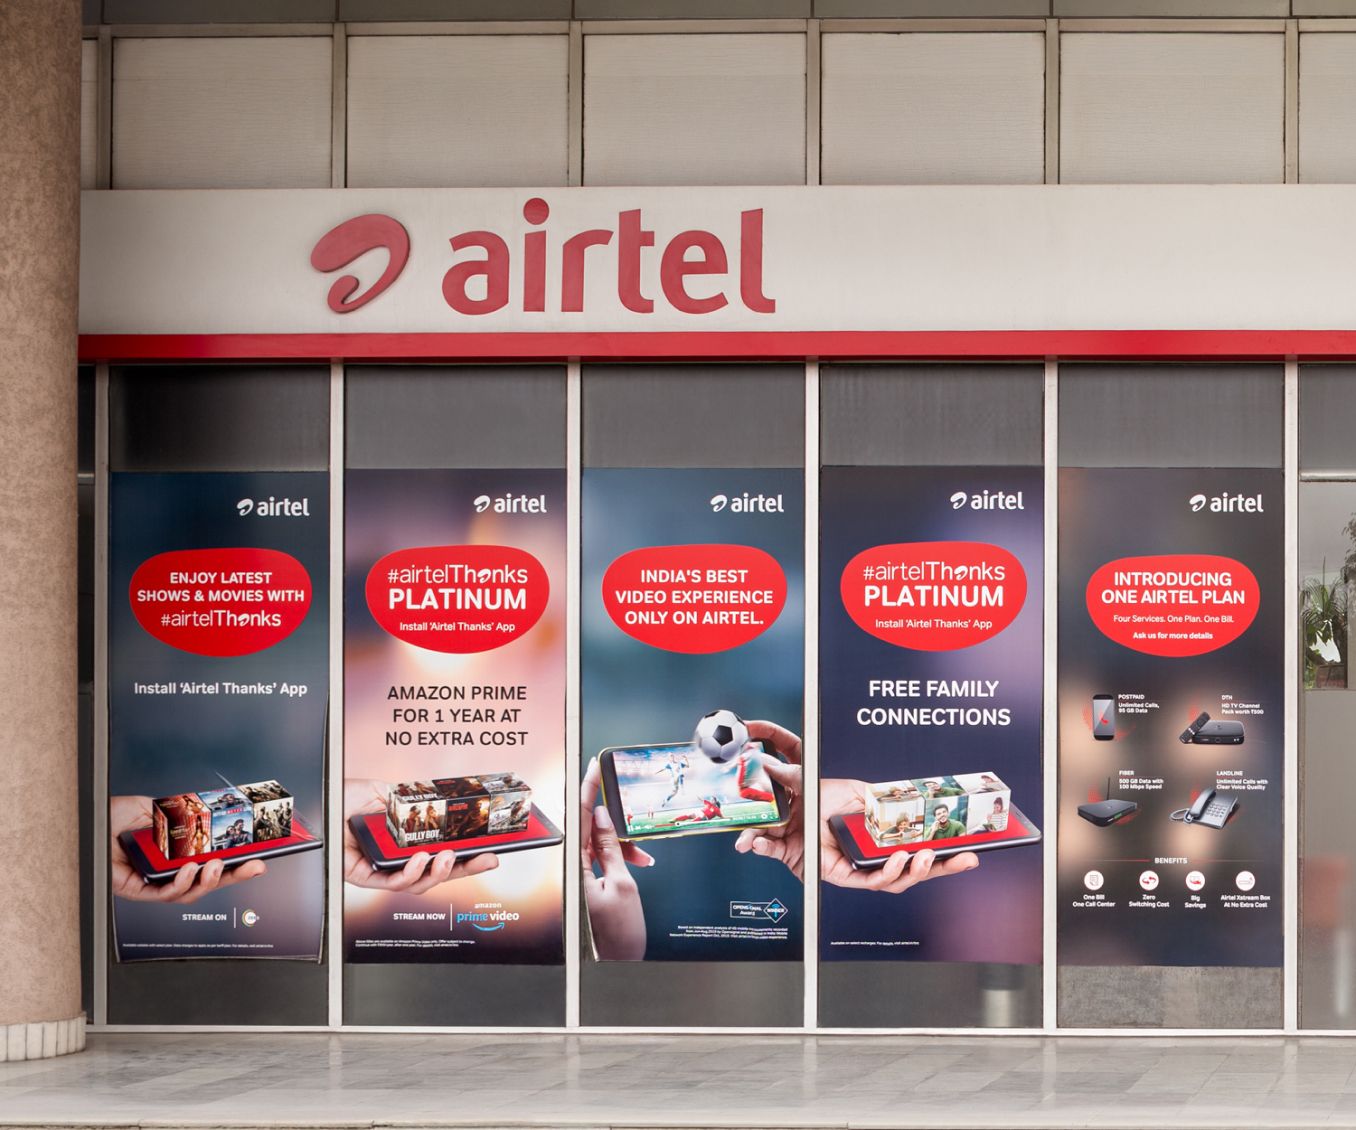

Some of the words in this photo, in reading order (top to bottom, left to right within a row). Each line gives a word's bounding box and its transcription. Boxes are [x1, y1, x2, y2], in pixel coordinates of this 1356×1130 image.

[442, 197, 776, 315] airtel
[257, 496, 310, 517] airtel
[494, 494, 547, 513] airtel
[731, 492, 784, 513] airtel
[971, 491, 1024, 510] airtel
[1210, 492, 1264, 512] airtel
[169, 572, 217, 584] ENJOY
[221, 572, 272, 584] LATEST
[641, 569, 701, 584] INDIA'S
[706, 569, 748, 584] BEST
[1114, 572, 1232, 586] INTRODUCING
[137, 589, 190, 602] SHOWS
[193, 589, 205, 602] &
[208, 589, 265, 602] MOVIES
[269, 589, 304, 602] WITH
[388, 588, 526, 610] PLATINUM
[615, 590, 666, 604] VIDEO
[671, 590, 773, 605] EXPERIENCE
[864, 586, 1004, 608] PLATINUM
[1102, 590, 1137, 604] ONE
[1141, 590, 1198, 604] AIRTEL
[1202, 590, 1245, 604] PLAN
[625, 611, 668, 625] ONLY
[673, 611, 698, 625] ON
[703, 611, 764, 625] AIRTEL.
[875, 619, 903, 629] Install
[973, 619, 992, 631] App
[399, 622, 427, 631] Install
[496, 622, 515, 633] App
[134, 682, 177, 695] Install
[281, 683, 307, 697] App
[387, 686, 465, 701] AMAZON
[471, 686, 527, 701] PRIME
[869, 680, 920, 697] FREE
[926, 680, 999, 698] FAMILY
[393, 708, 428, 723] FOR
[434, 708, 443, 723] 1
[449, 708, 495, 723] YEAR
[500, 708, 521, 723] AT
[856, 708, 1011, 726] CONNECTIONS
[385, 731, 412, 746] NO
[418, 731, 474, 746] EXTRA
[479, 731, 528, 746] COST
[405, 831, 425, 842] GULLY
[425, 829, 440, 839] BOY
[456, 912, 488, 923] prime
[490, 911, 519, 920] video
